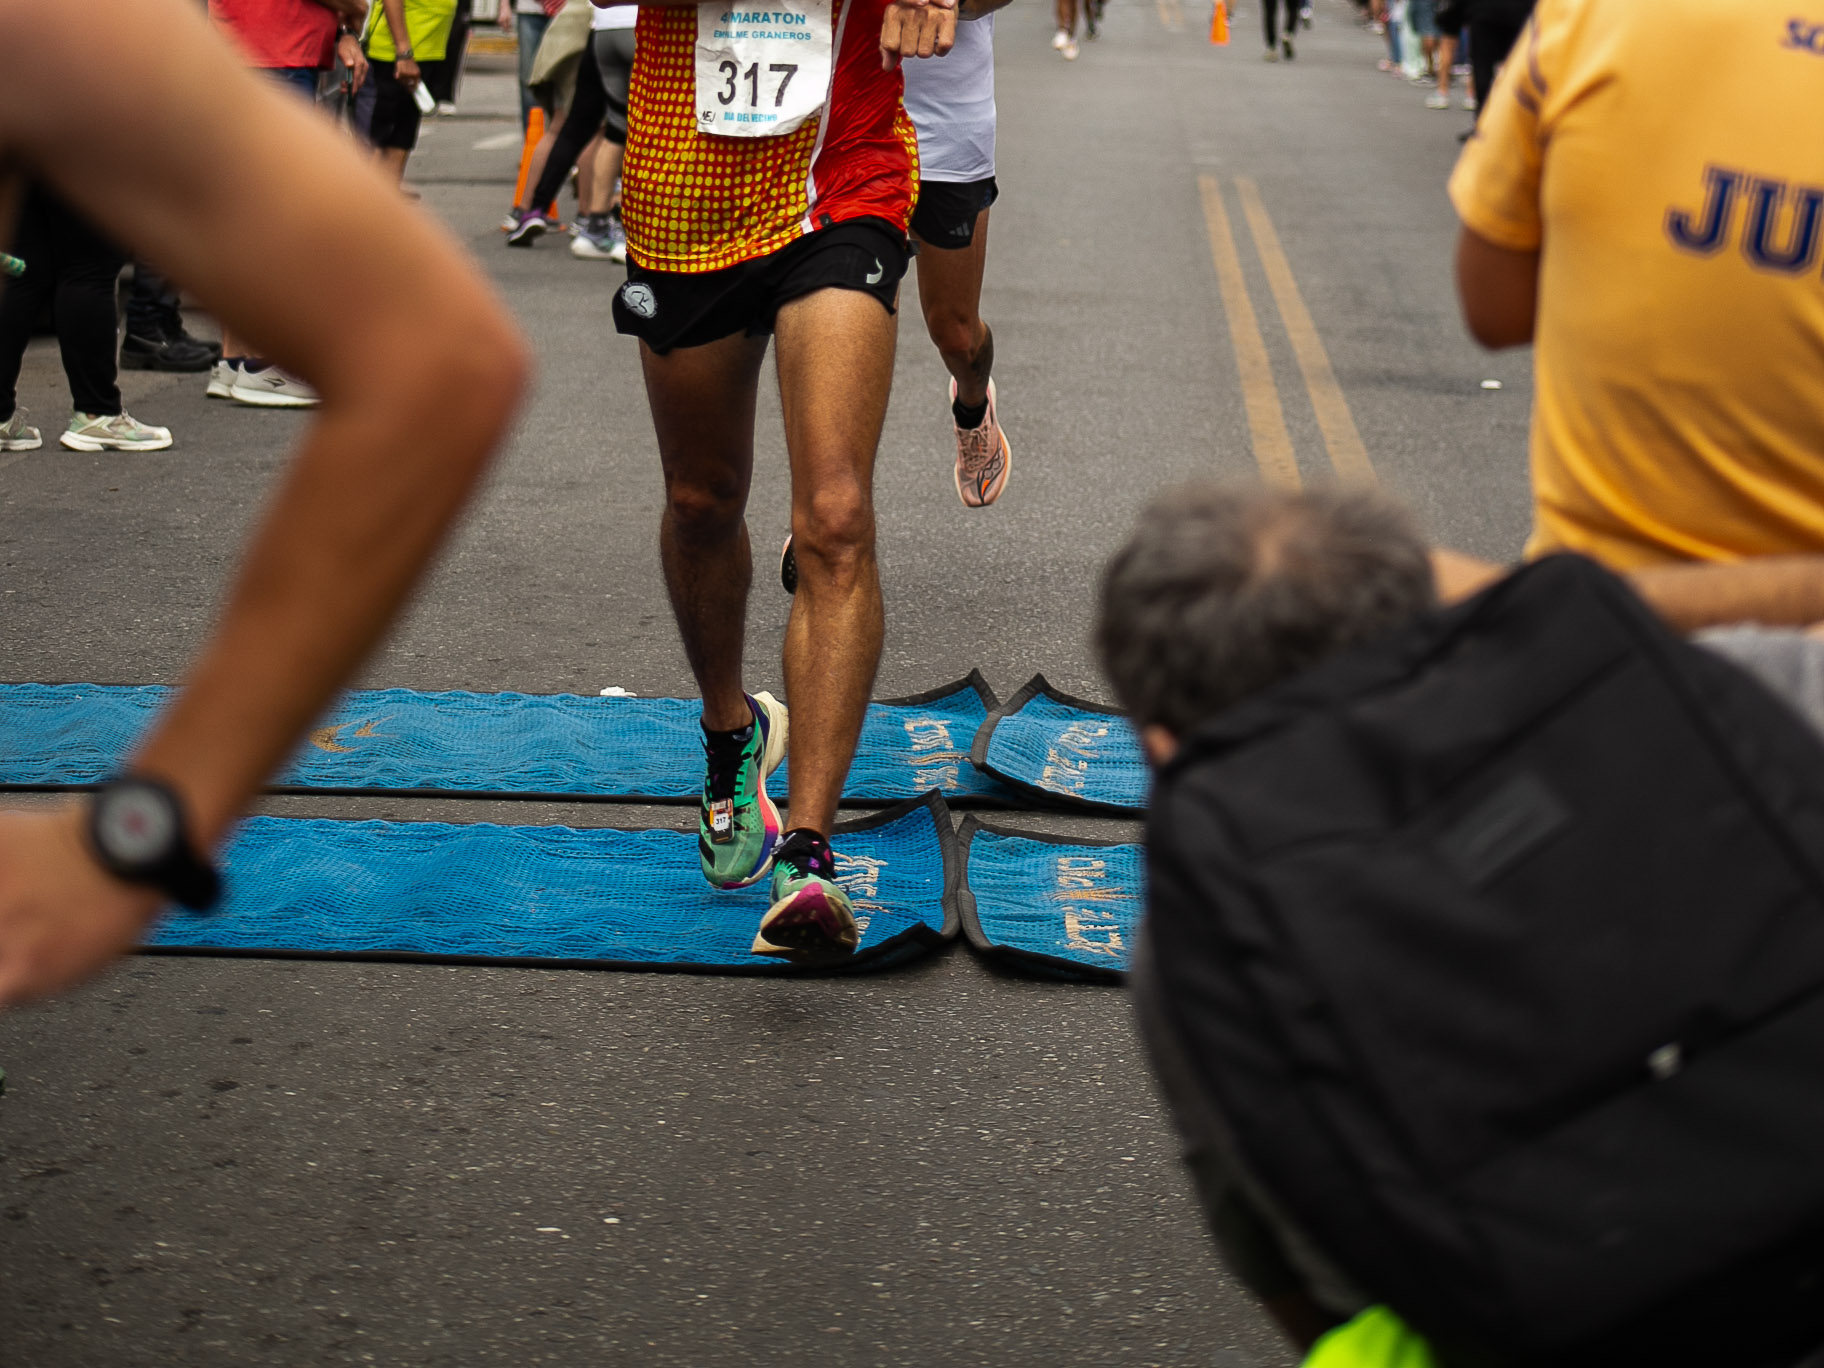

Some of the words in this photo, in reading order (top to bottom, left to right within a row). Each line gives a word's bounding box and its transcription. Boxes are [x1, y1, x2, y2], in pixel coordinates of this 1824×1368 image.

[751, 30, 812, 41] GRANEROS
[717, 60, 799, 107] 317
[737, 113, 749, 122] DEL
[716, 816, 727, 824] 317
